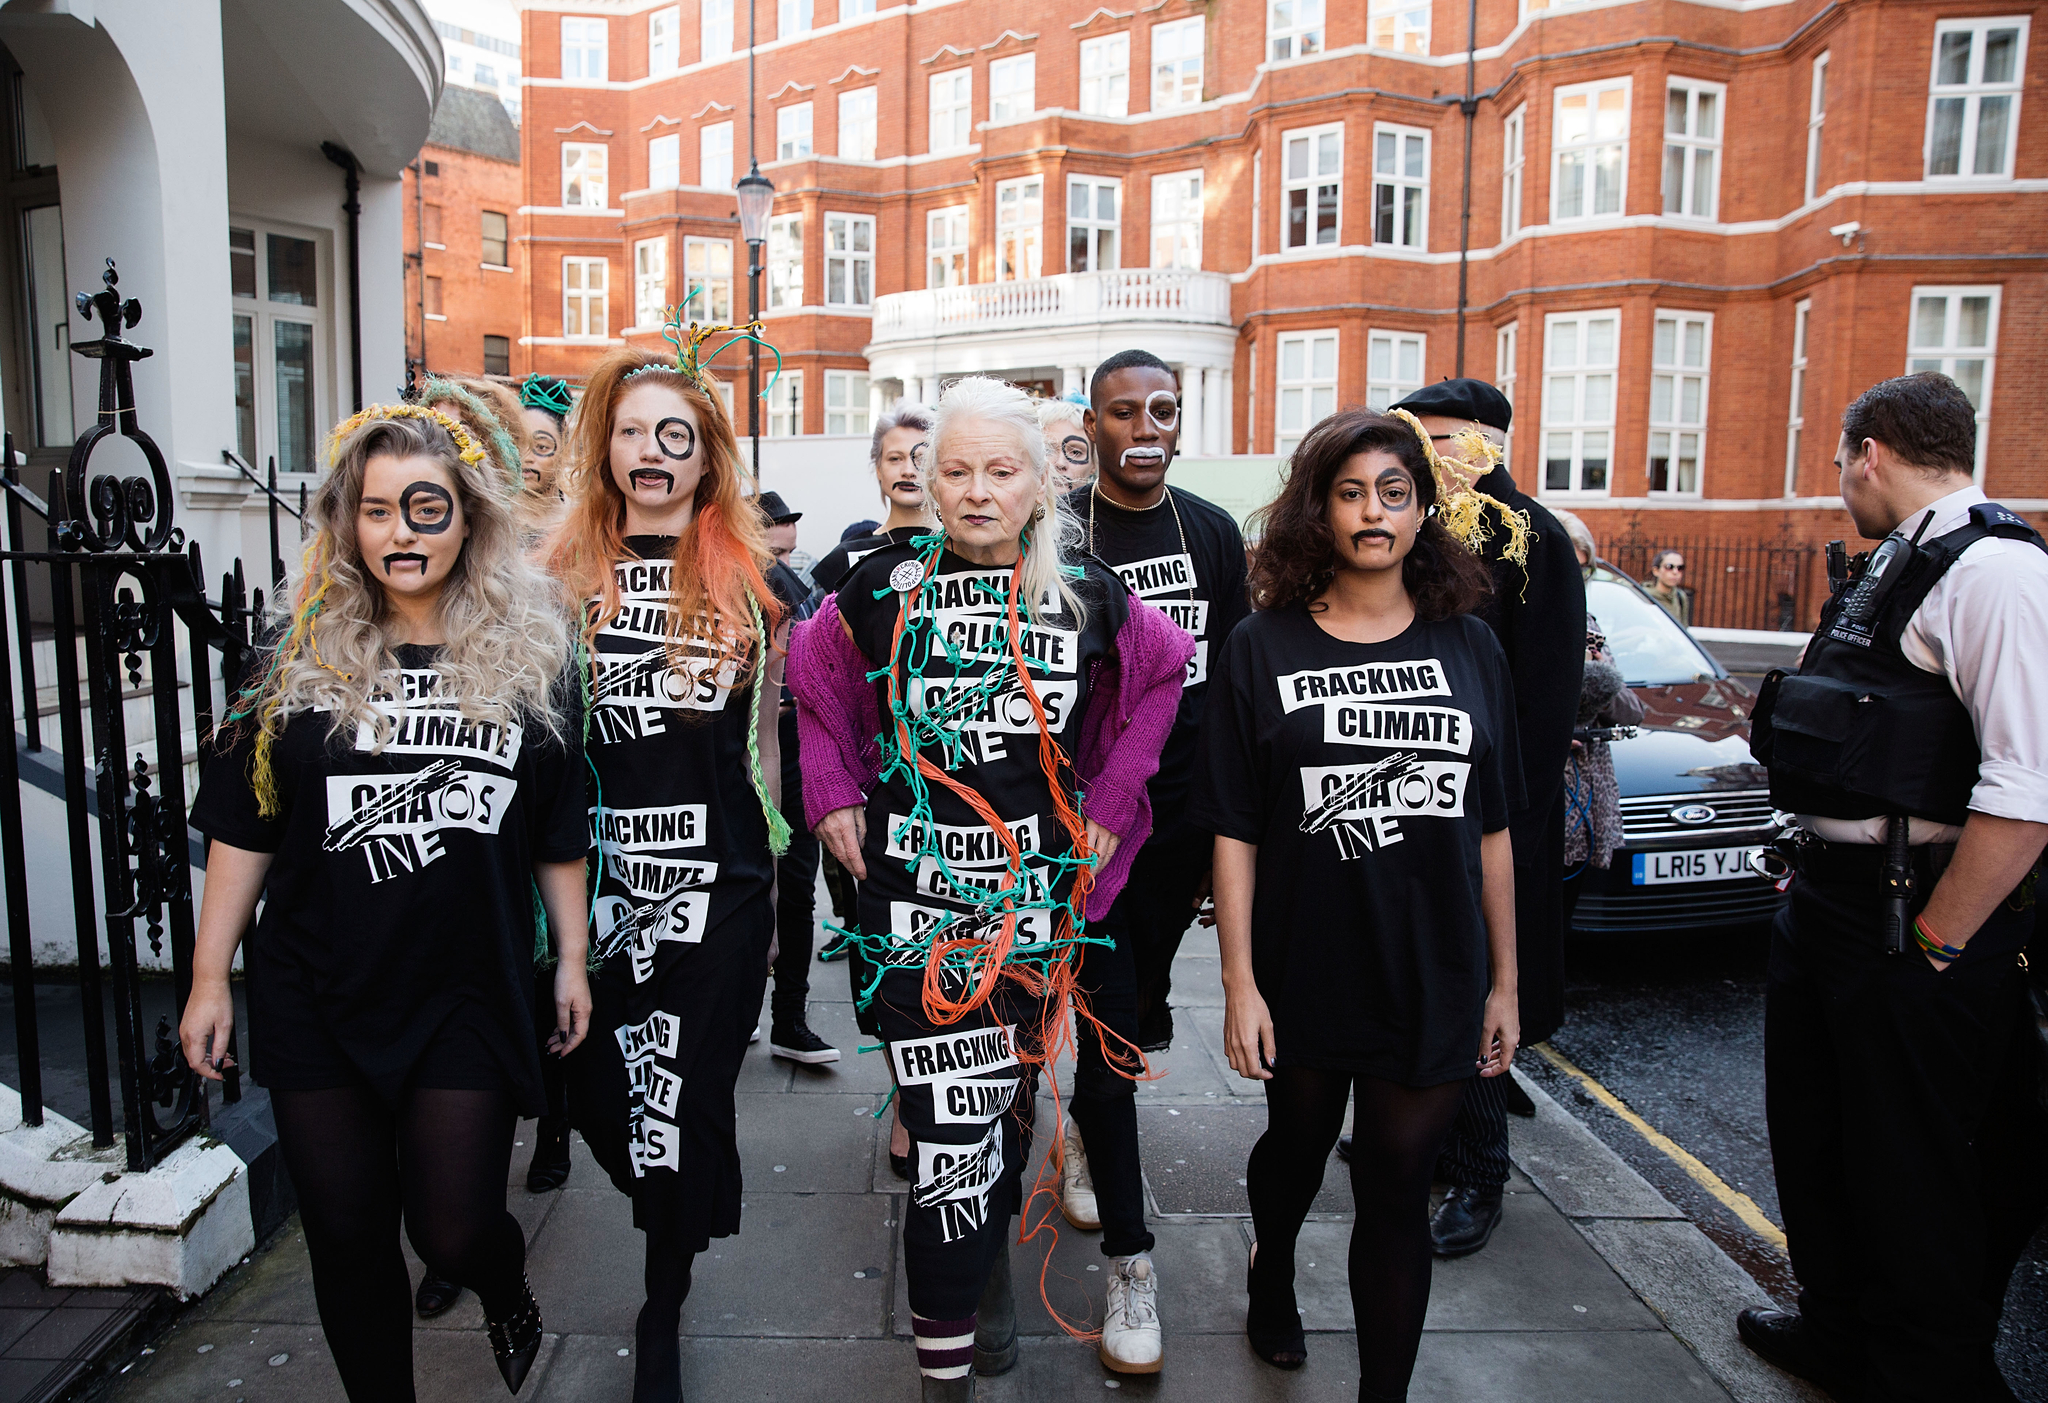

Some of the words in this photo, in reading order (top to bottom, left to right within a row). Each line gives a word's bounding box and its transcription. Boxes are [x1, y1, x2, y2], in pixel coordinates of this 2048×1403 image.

[1119, 559, 1187, 591] CKING
[1831, 629, 1848, 639] POLICE
[1848, 633, 1871, 647] OFFICER
[1293, 665, 1439, 702] FRACKING
[1337, 707, 1460, 746] CLIMATE
[588, 810, 695, 845] RACKING
[1329, 807, 1404, 861] INE
[360, 821, 447, 884] INE
[1655, 854, 1706, 879] LR15
[612, 854, 705, 894] CLIMATE
[900, 1031, 1010, 1077] FRACKING
